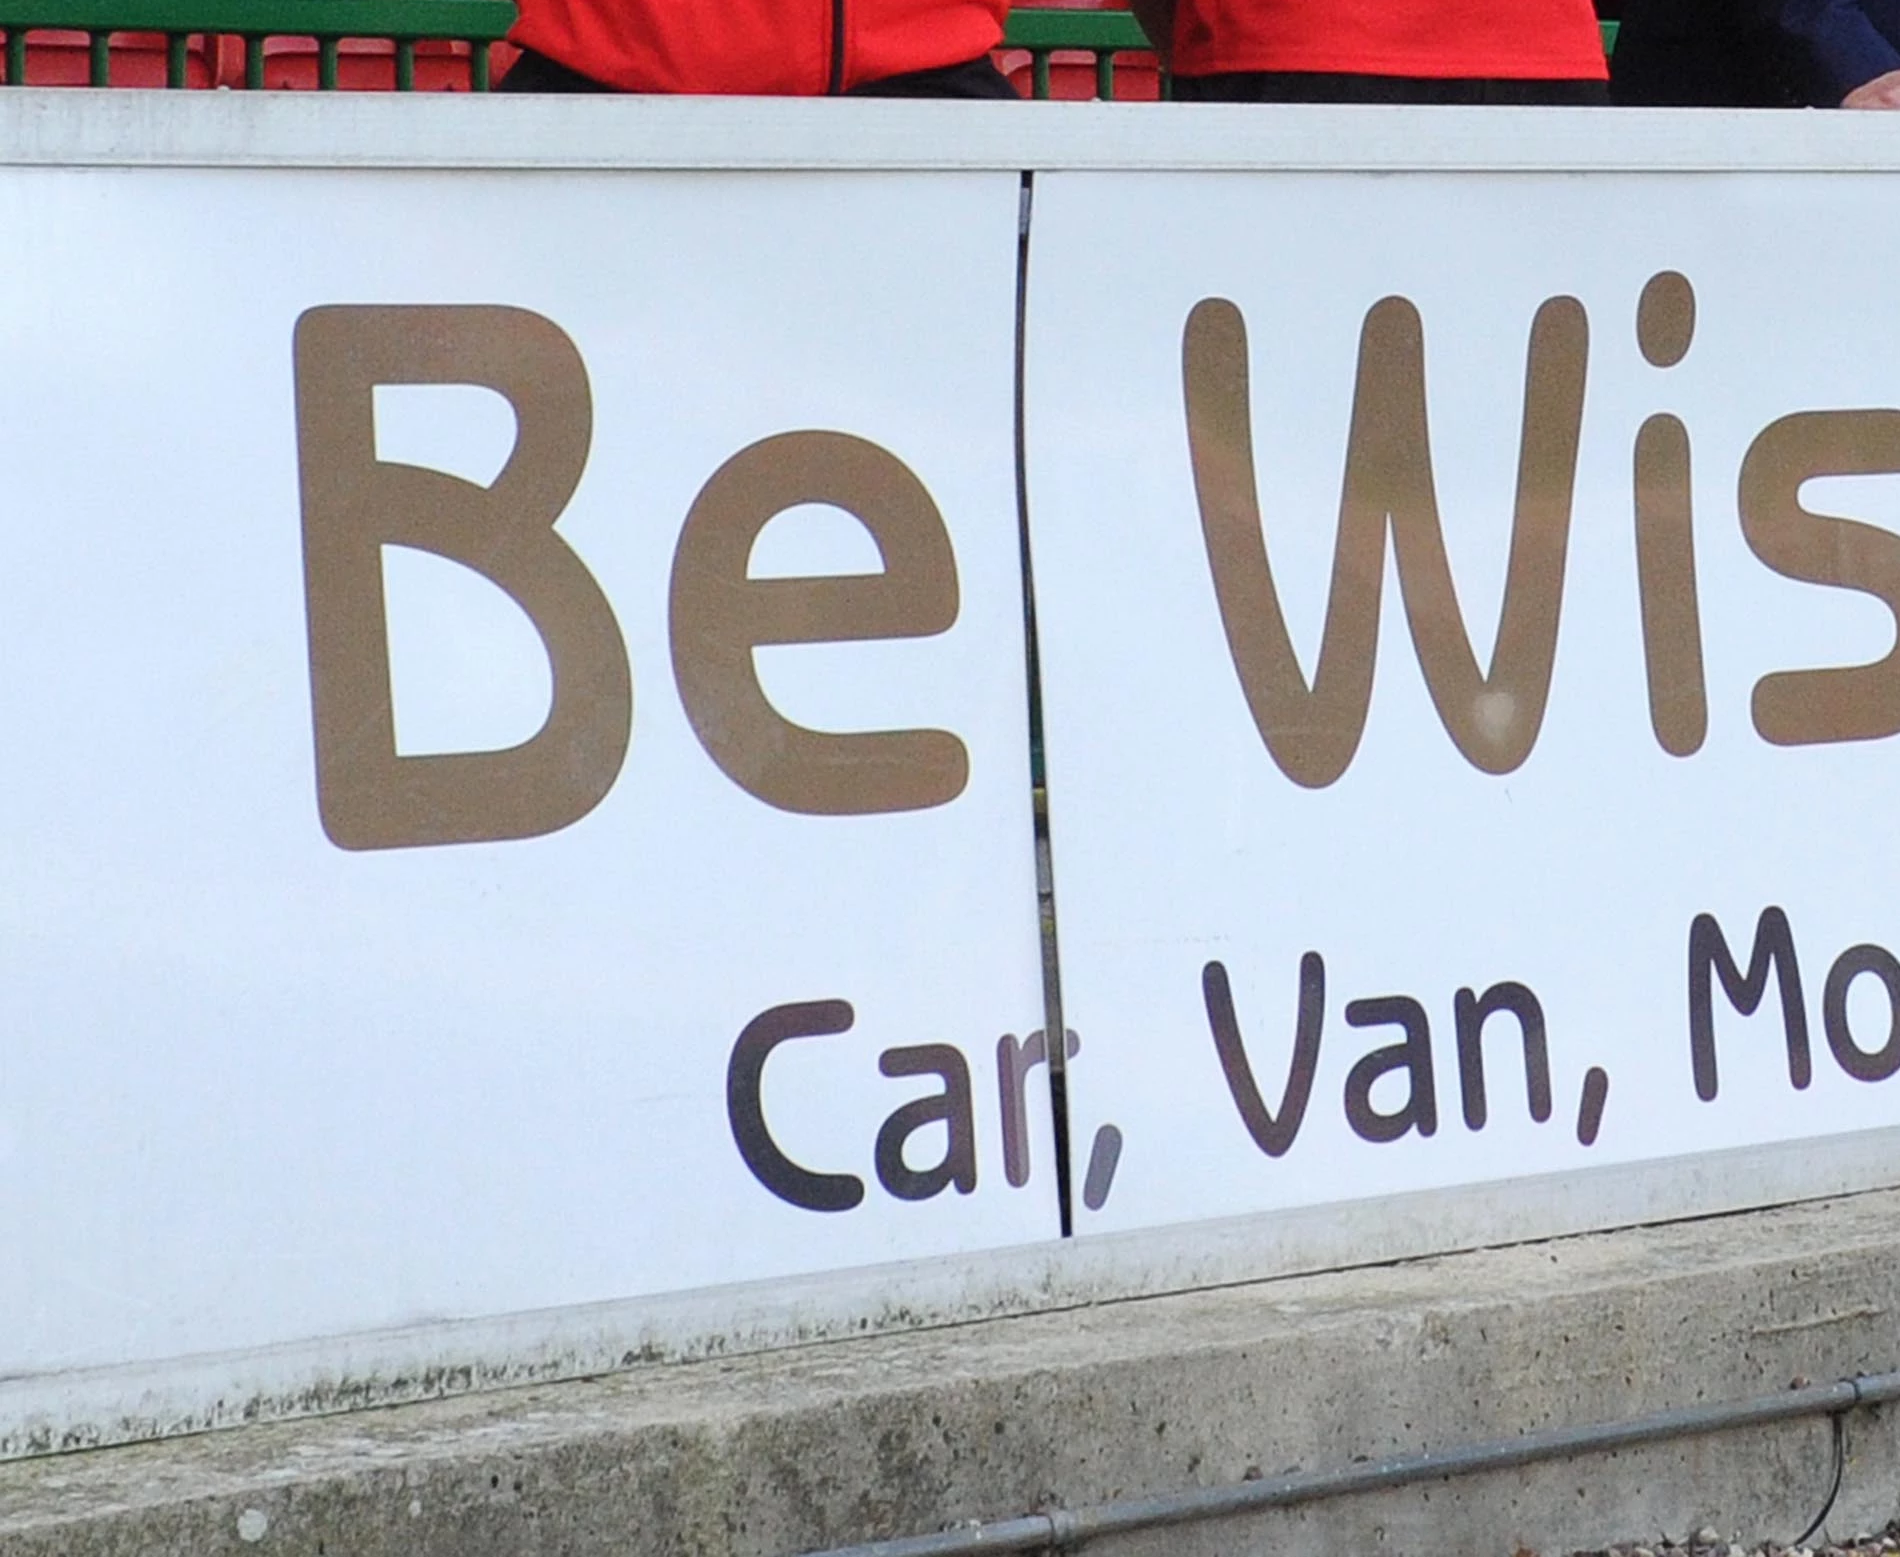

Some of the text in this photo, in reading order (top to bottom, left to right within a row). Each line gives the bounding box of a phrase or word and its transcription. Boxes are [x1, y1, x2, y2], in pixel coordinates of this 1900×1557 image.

[293, 303, 970, 852] Be
[726, 998, 1123, 1213] Car,
[1202, 950, 1609, 1147] Van,
